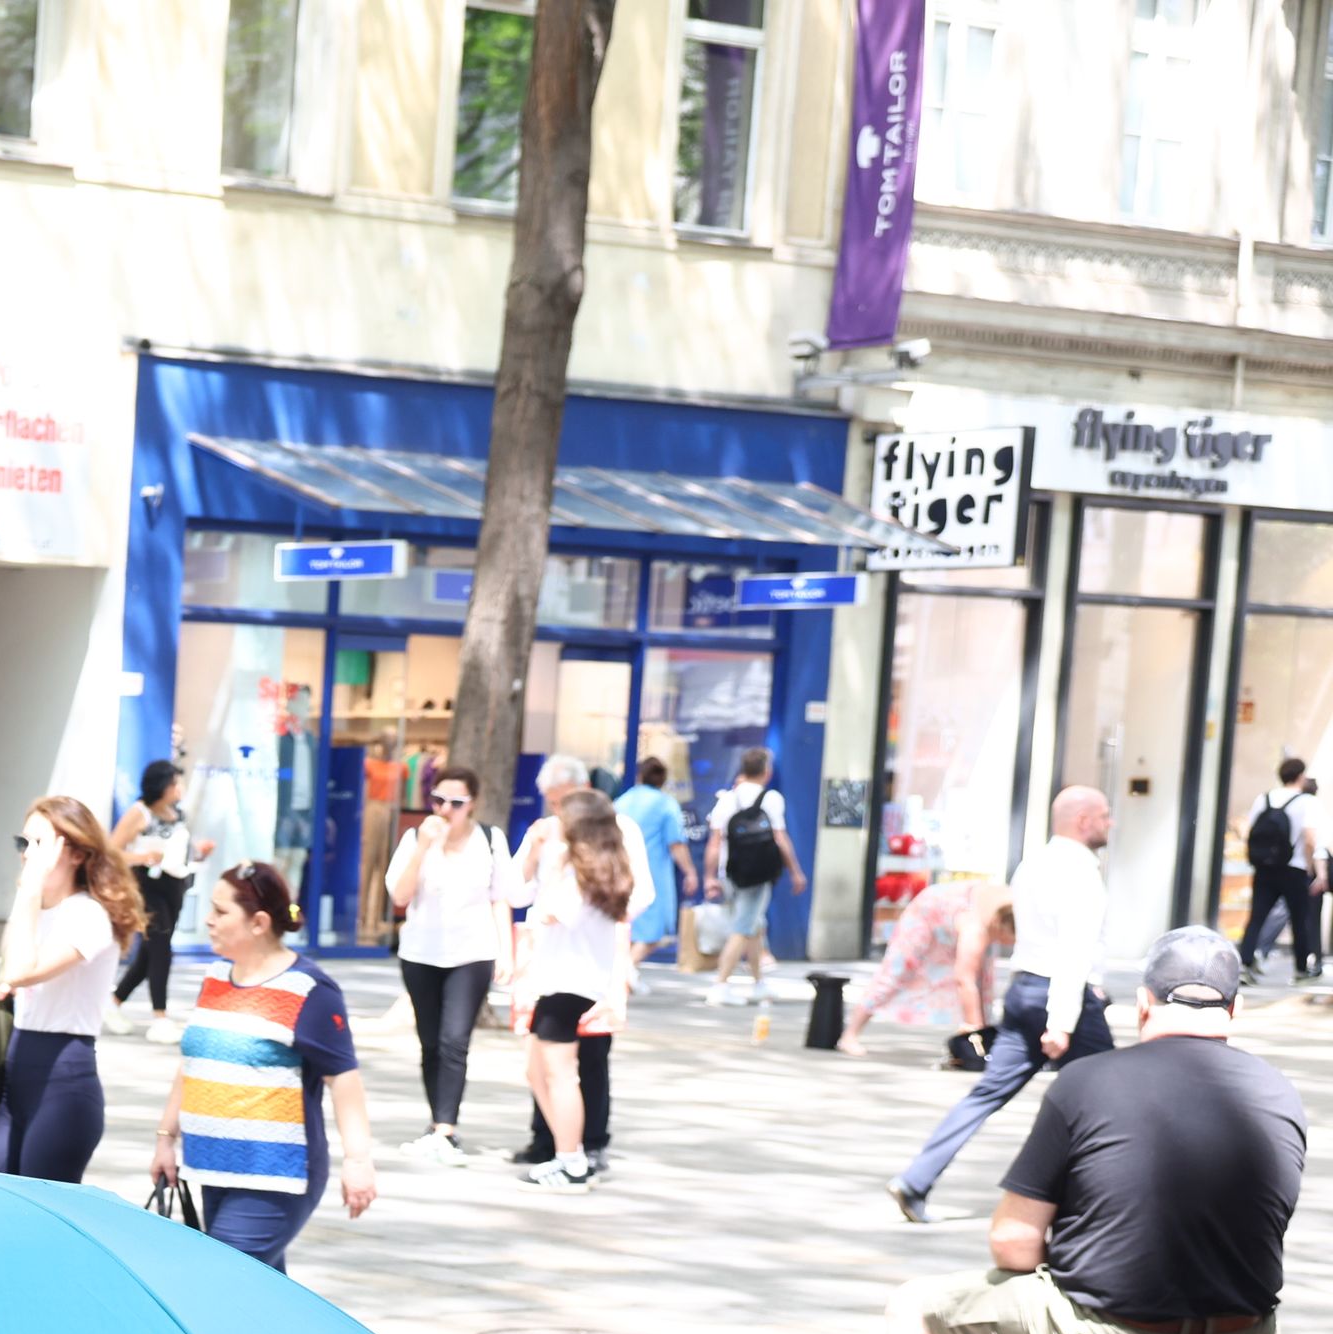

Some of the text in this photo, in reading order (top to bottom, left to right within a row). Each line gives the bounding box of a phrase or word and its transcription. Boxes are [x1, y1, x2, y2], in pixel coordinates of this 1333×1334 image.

[874, 50, 908, 237] TOM TAILOR
[883, 436, 1014, 490] flying
[1074, 408, 1273, 469] flying tiger
[891, 486, 1003, 536] tiger
